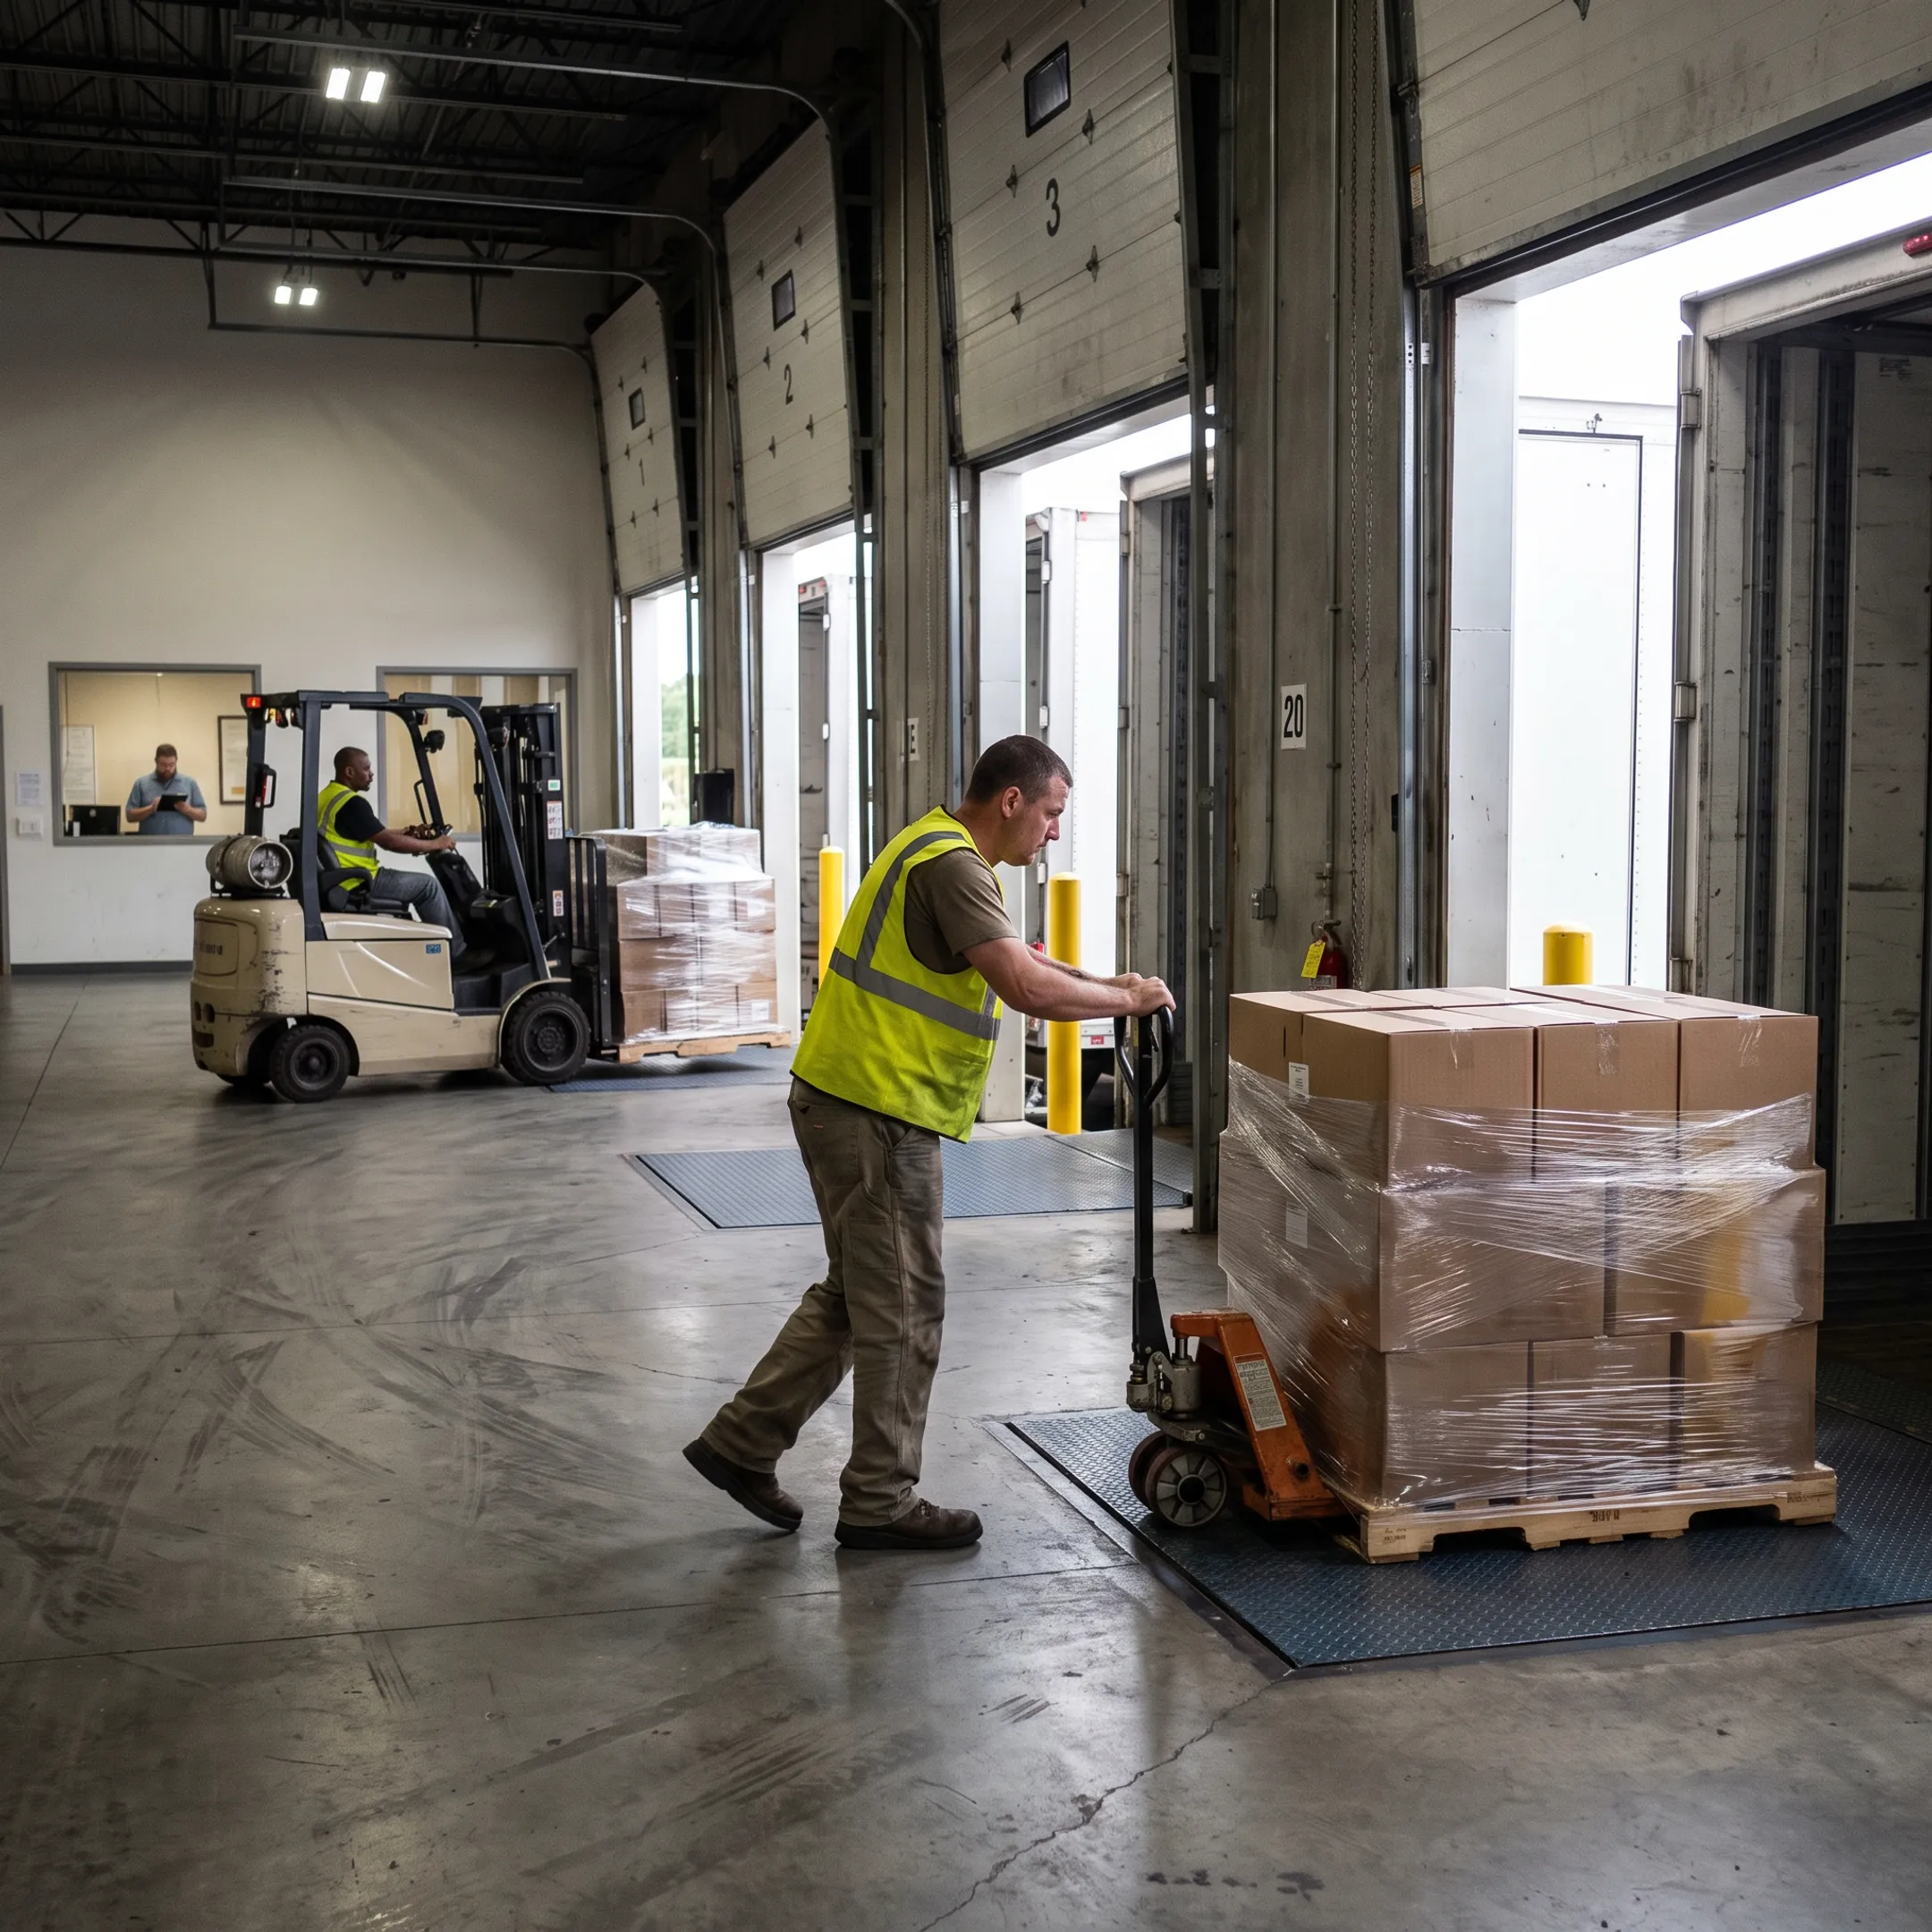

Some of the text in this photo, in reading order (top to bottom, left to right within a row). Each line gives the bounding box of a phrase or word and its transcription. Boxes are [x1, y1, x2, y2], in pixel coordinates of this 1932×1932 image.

[1046, 177, 1061, 237] 3
[784, 363, 793, 405] 2
[639, 457, 645, 486] 1
[1284, 693, 1303, 738] 20
